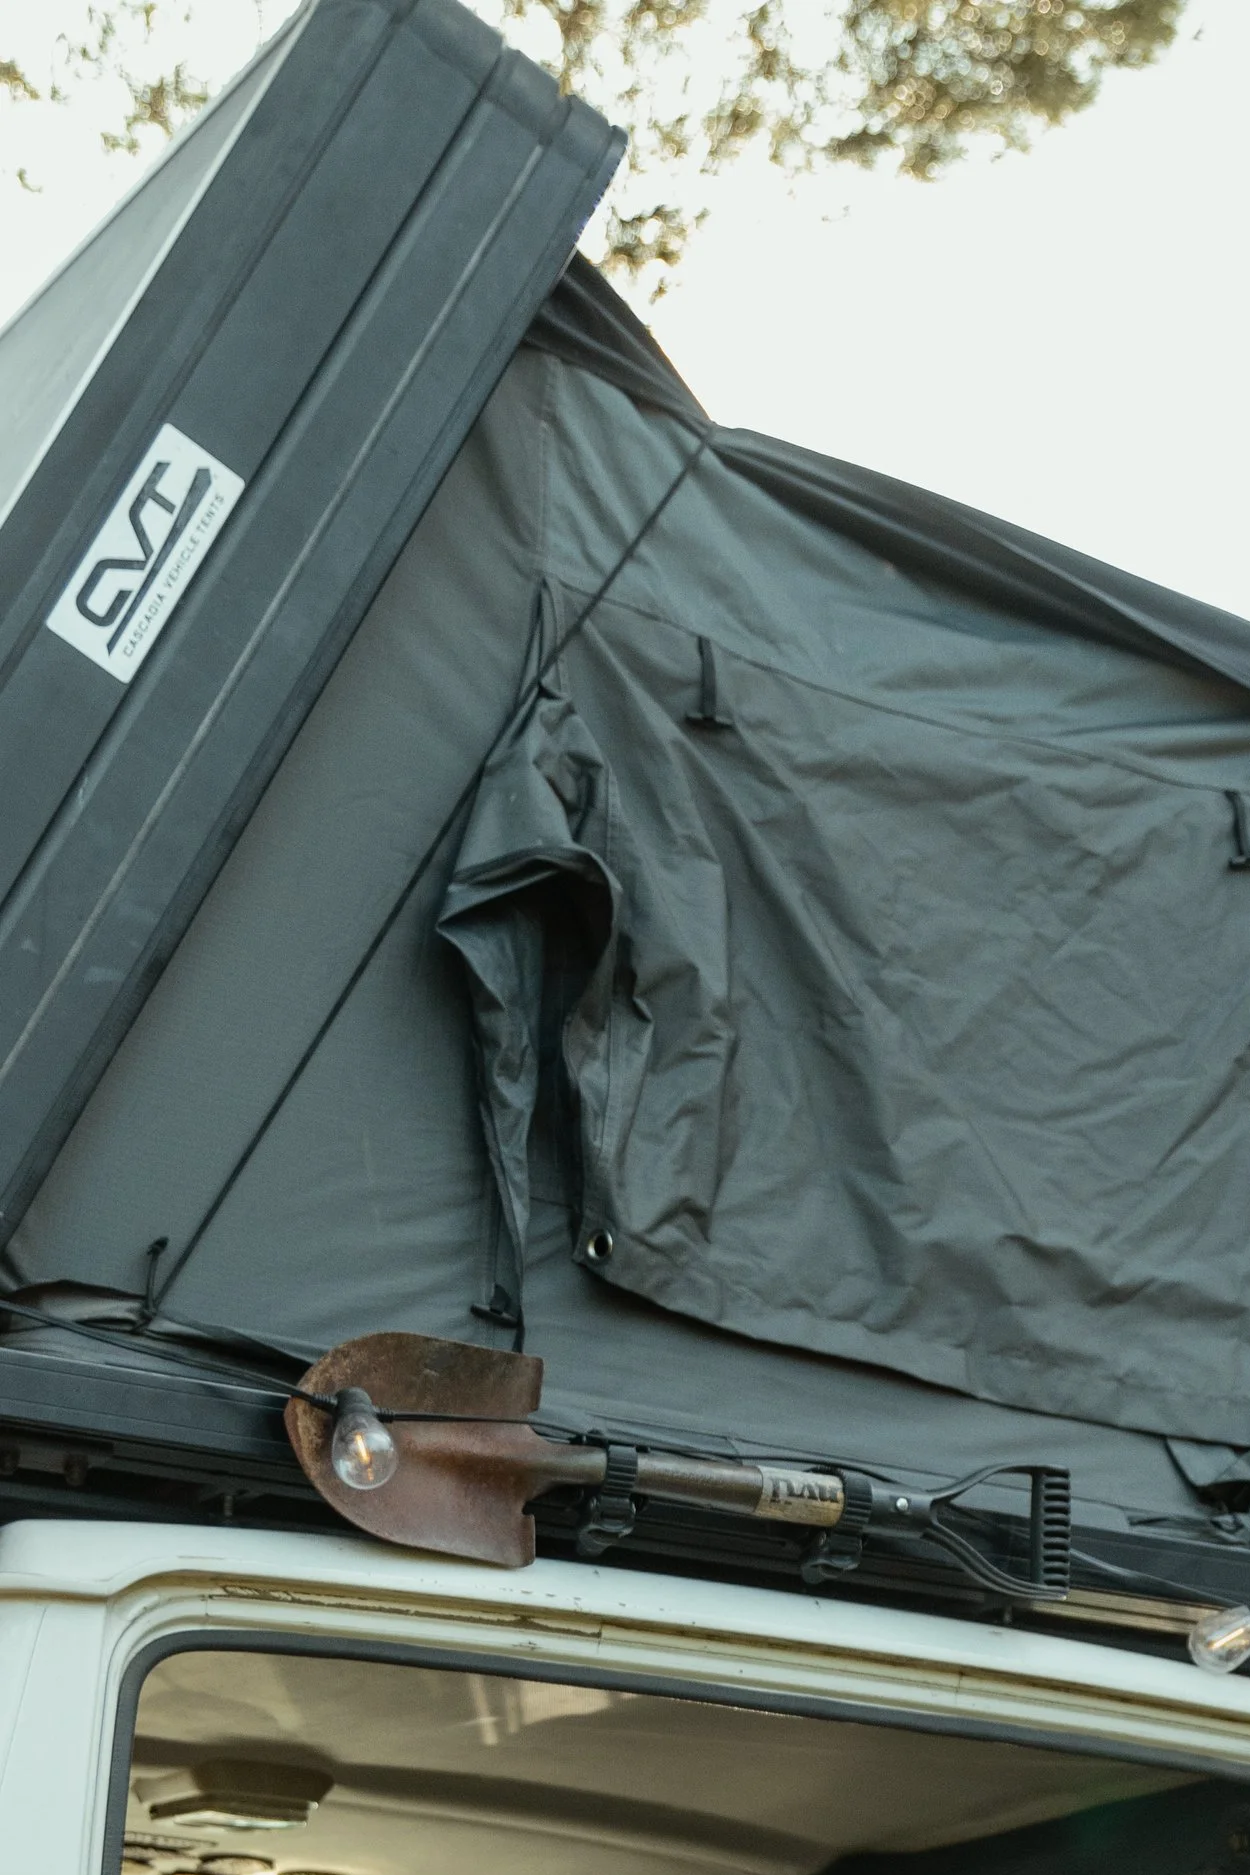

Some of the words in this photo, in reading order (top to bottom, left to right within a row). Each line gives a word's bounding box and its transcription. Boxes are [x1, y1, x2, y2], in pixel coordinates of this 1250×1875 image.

[123, 592, 165, 658] CASCADIA
[163, 531, 199, 590] VEHICLE
[198, 493, 225, 535] TENTS
